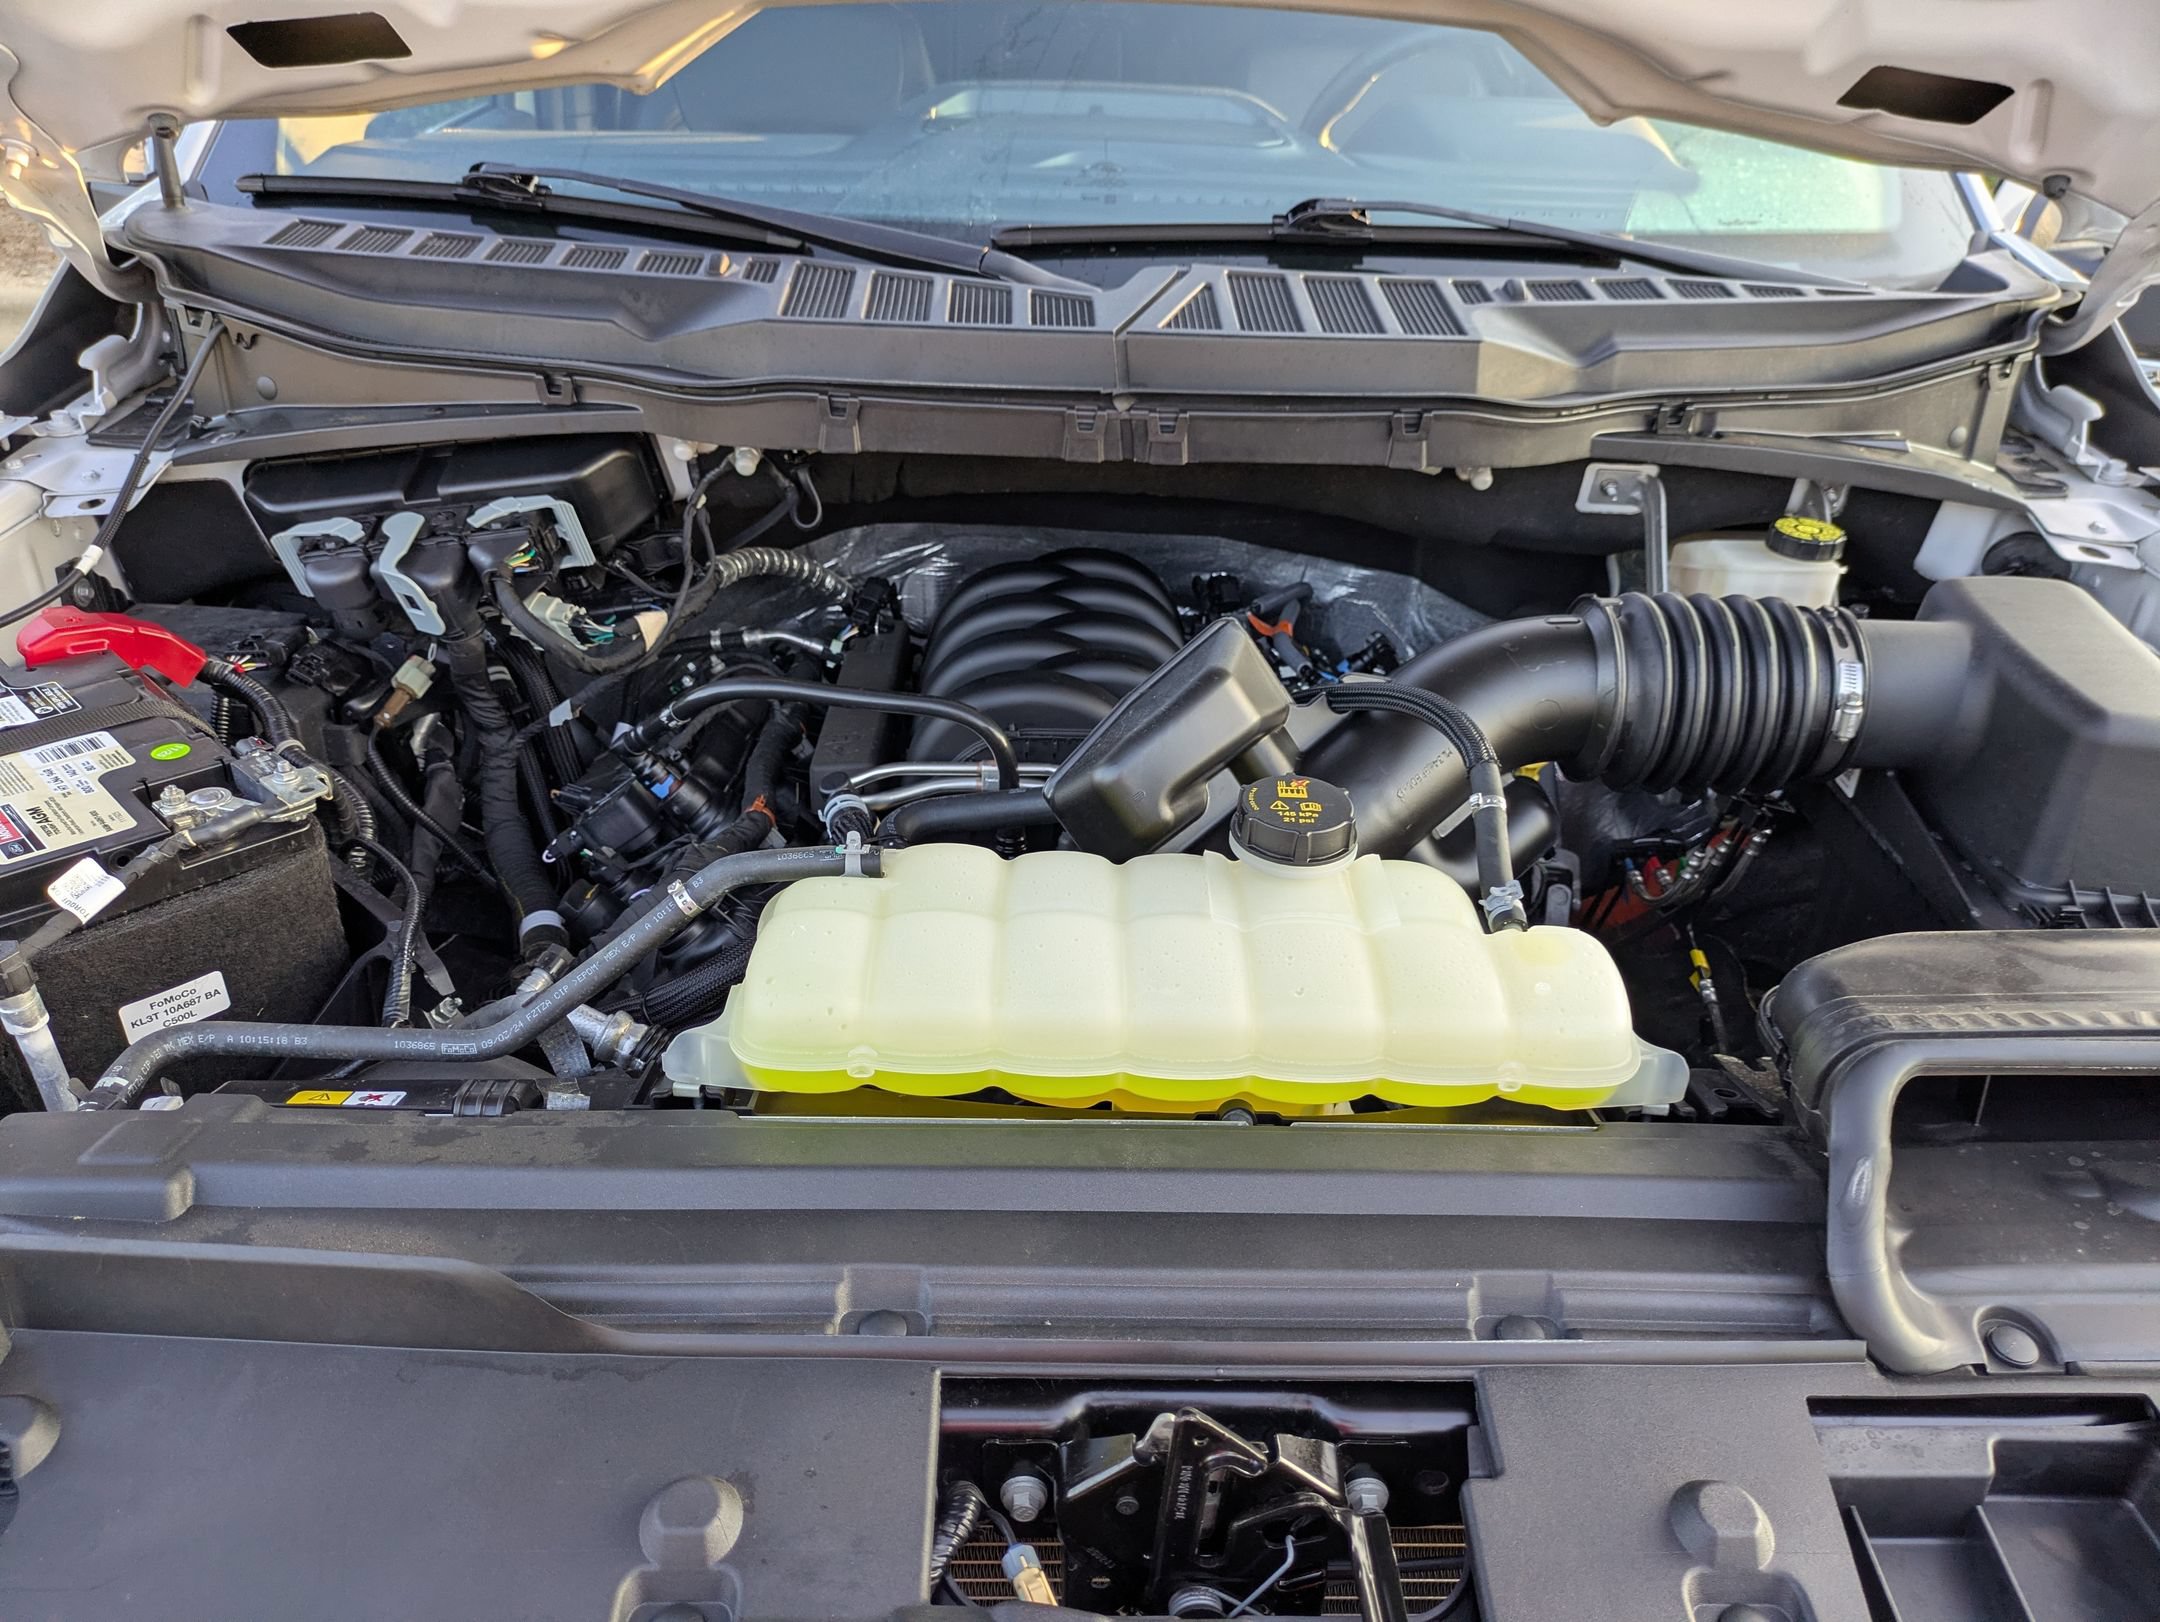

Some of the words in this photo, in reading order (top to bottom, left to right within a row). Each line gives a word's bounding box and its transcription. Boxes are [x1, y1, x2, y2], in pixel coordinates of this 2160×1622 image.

[26, 806, 53, 824] AGM
[394, 1041, 436, 1050] 1036865
[603, 946, 621, 962] MEX
[621, 933, 637, 948] E/P
[644, 922, 652, 930] A
[692, 876, 704, 889] B3
[130, 1012, 160, 1029] KL3T
[164, 995, 202, 1016] 10A687
[204, 988, 222, 1000] BA
[149, 988, 197, 1010] FoMoCo
[162, 1010, 198, 1028] C500L
[197, 1034, 216, 1044] E/P
[226, 1035, 234, 1043] A
[239, 1035, 288, 1045] 10:15:18
[294, 1037, 308, 1045] B3
